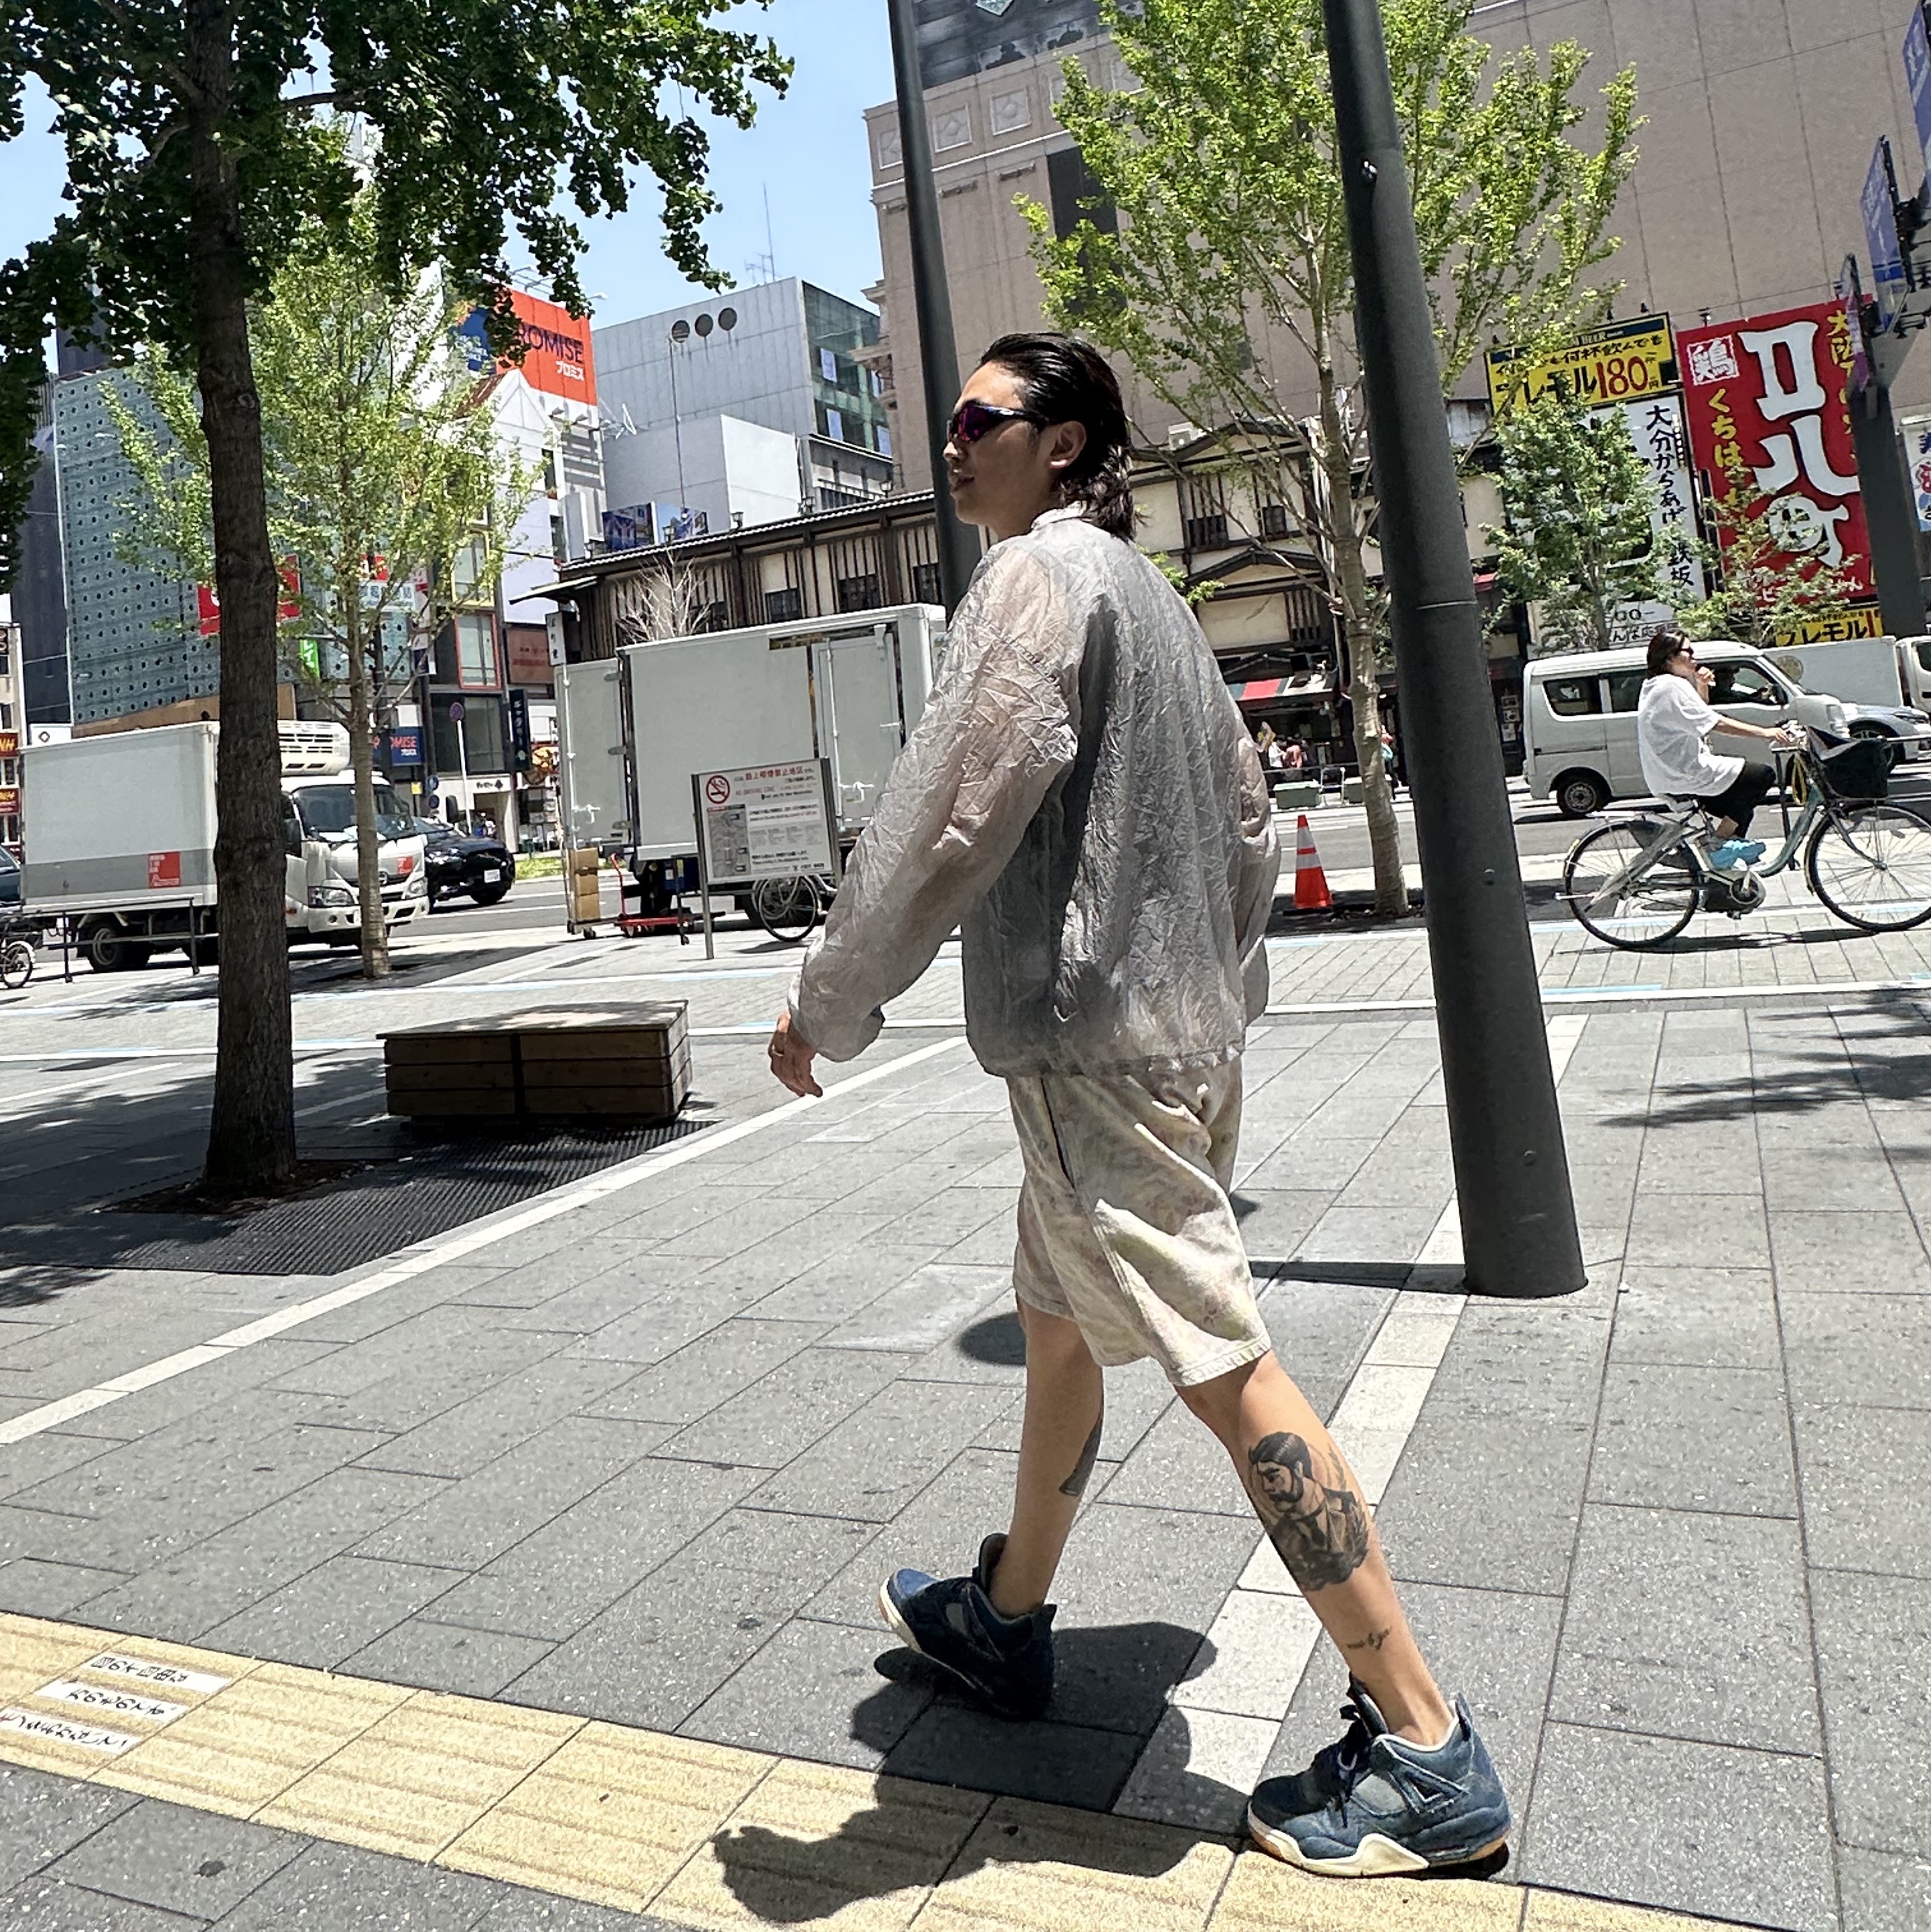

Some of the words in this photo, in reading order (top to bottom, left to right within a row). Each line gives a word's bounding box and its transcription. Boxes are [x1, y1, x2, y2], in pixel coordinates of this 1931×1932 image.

[519, 322, 584, 364] ROMISE
[1690, 339, 1737, 385] 鶏
[556, 360, 584, 381] プロミス
